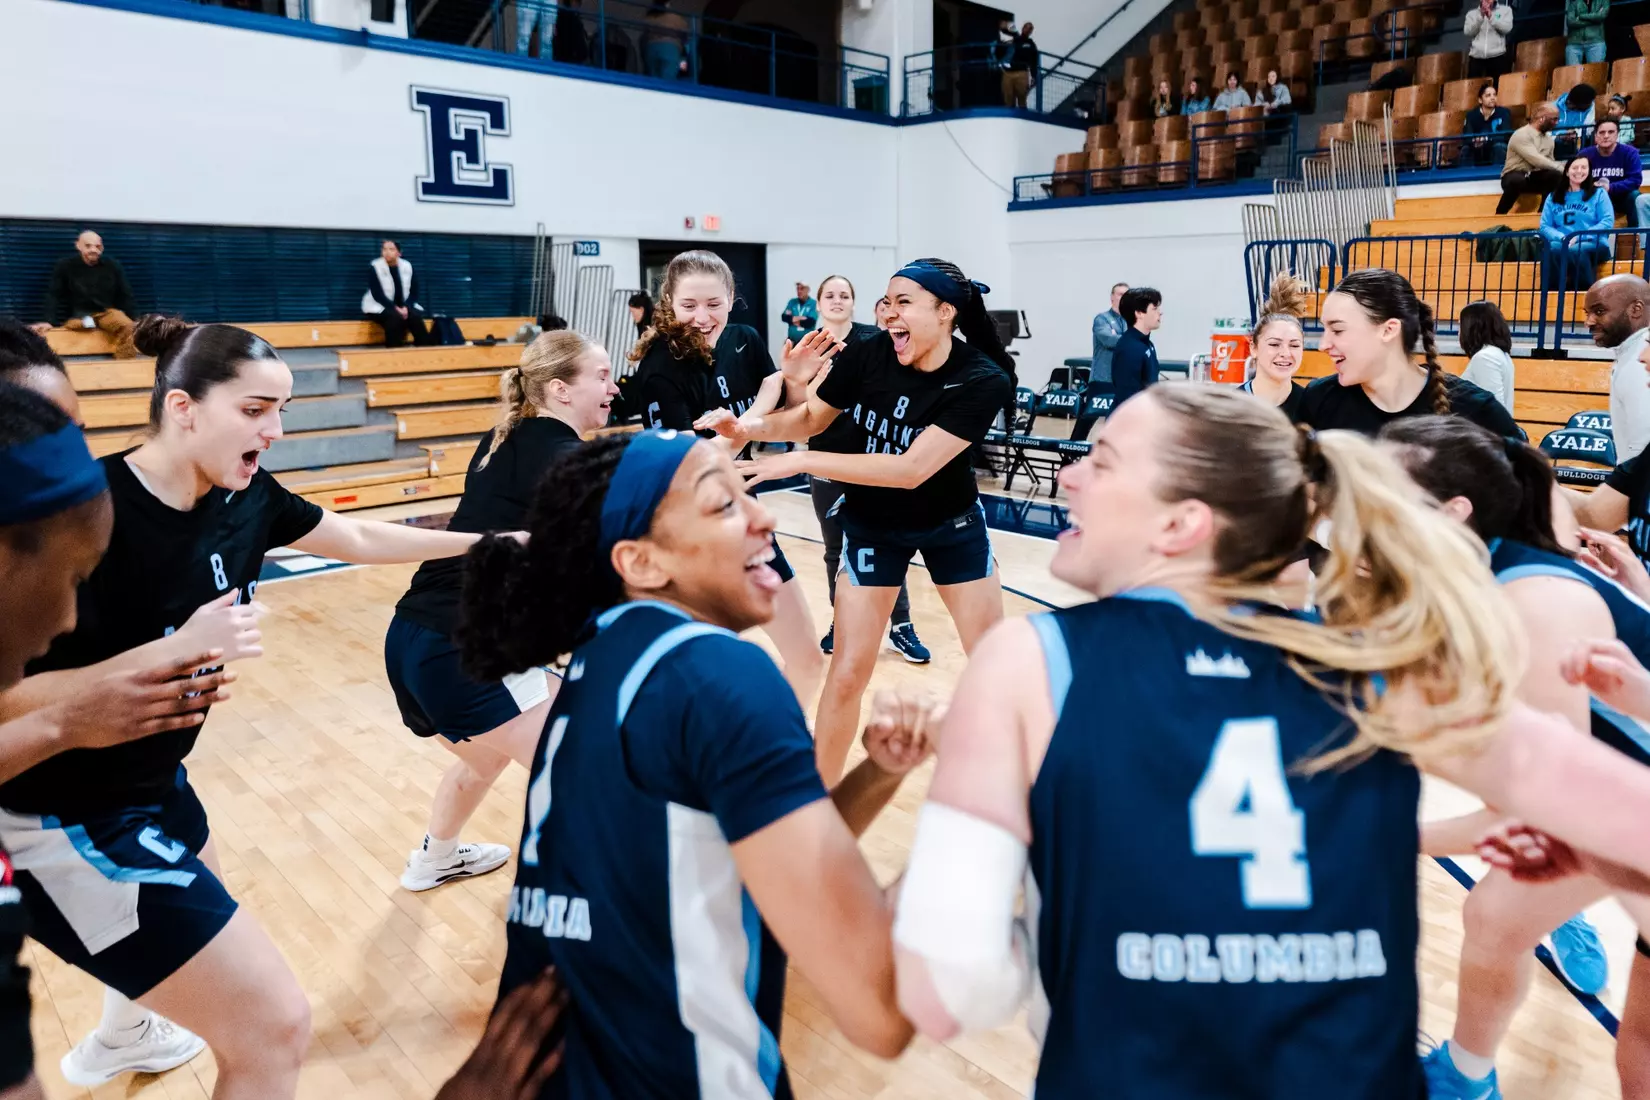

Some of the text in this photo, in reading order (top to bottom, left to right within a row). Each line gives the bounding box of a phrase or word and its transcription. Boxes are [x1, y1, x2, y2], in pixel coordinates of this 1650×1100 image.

[409, 84, 515, 207] E
[1602, 168, 1624, 177] CROSS
[1563, 211, 1576, 226] C
[717, 375, 730, 399] 8
[893, 396, 910, 420] 8
[1045, 393, 1077, 406] YALE
[1012, 437, 1040, 446] BULLDOGS
[1058, 443, 1088, 452] BULLDOGS
[1549, 434, 1609, 452] YALE
[1557, 470, 1606, 481] BULLDOGS
[210, 553, 229, 591] 8
[857, 548, 875, 573] C
[1188, 715, 1313, 909] 4
[137, 825, 187, 864] C
[1116, 929, 1387, 984] COLUMBIA
